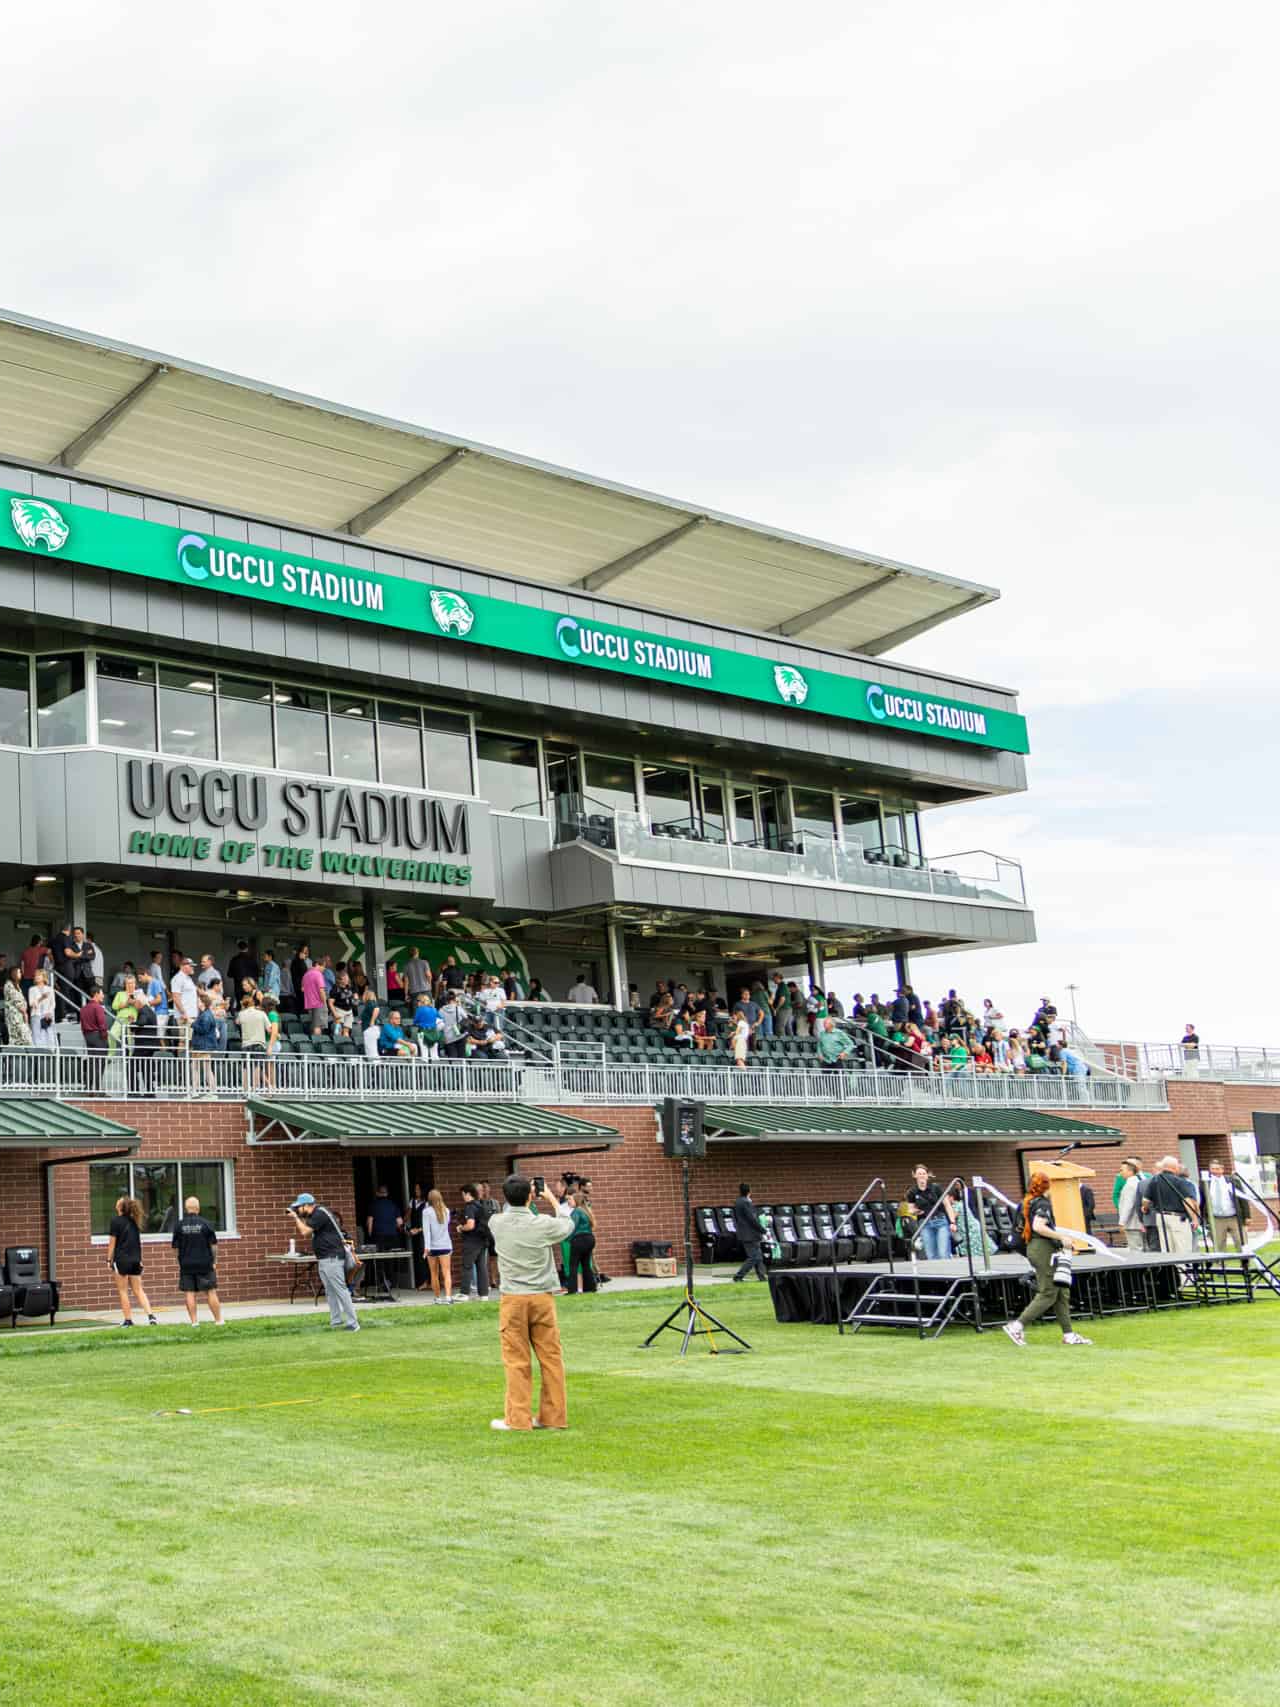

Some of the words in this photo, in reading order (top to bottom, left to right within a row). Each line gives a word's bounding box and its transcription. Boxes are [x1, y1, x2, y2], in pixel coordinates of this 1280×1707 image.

[209, 547, 275, 588] UCCU
[282, 563, 384, 611] STADIUM
[580, 628, 629, 661] UCCU
[634, 640, 712, 679] STADIUM
[886, 695, 923, 721] UCCU
[927, 704, 986, 735] STADIUM
[128, 759, 268, 831] UCCU
[283, 780, 469, 856] STADIUM
[128, 831, 211, 859] HOME
[220, 840, 256, 865] OF
[263, 844, 315, 871] THE
[322, 850, 473, 887] WOLVERINES
